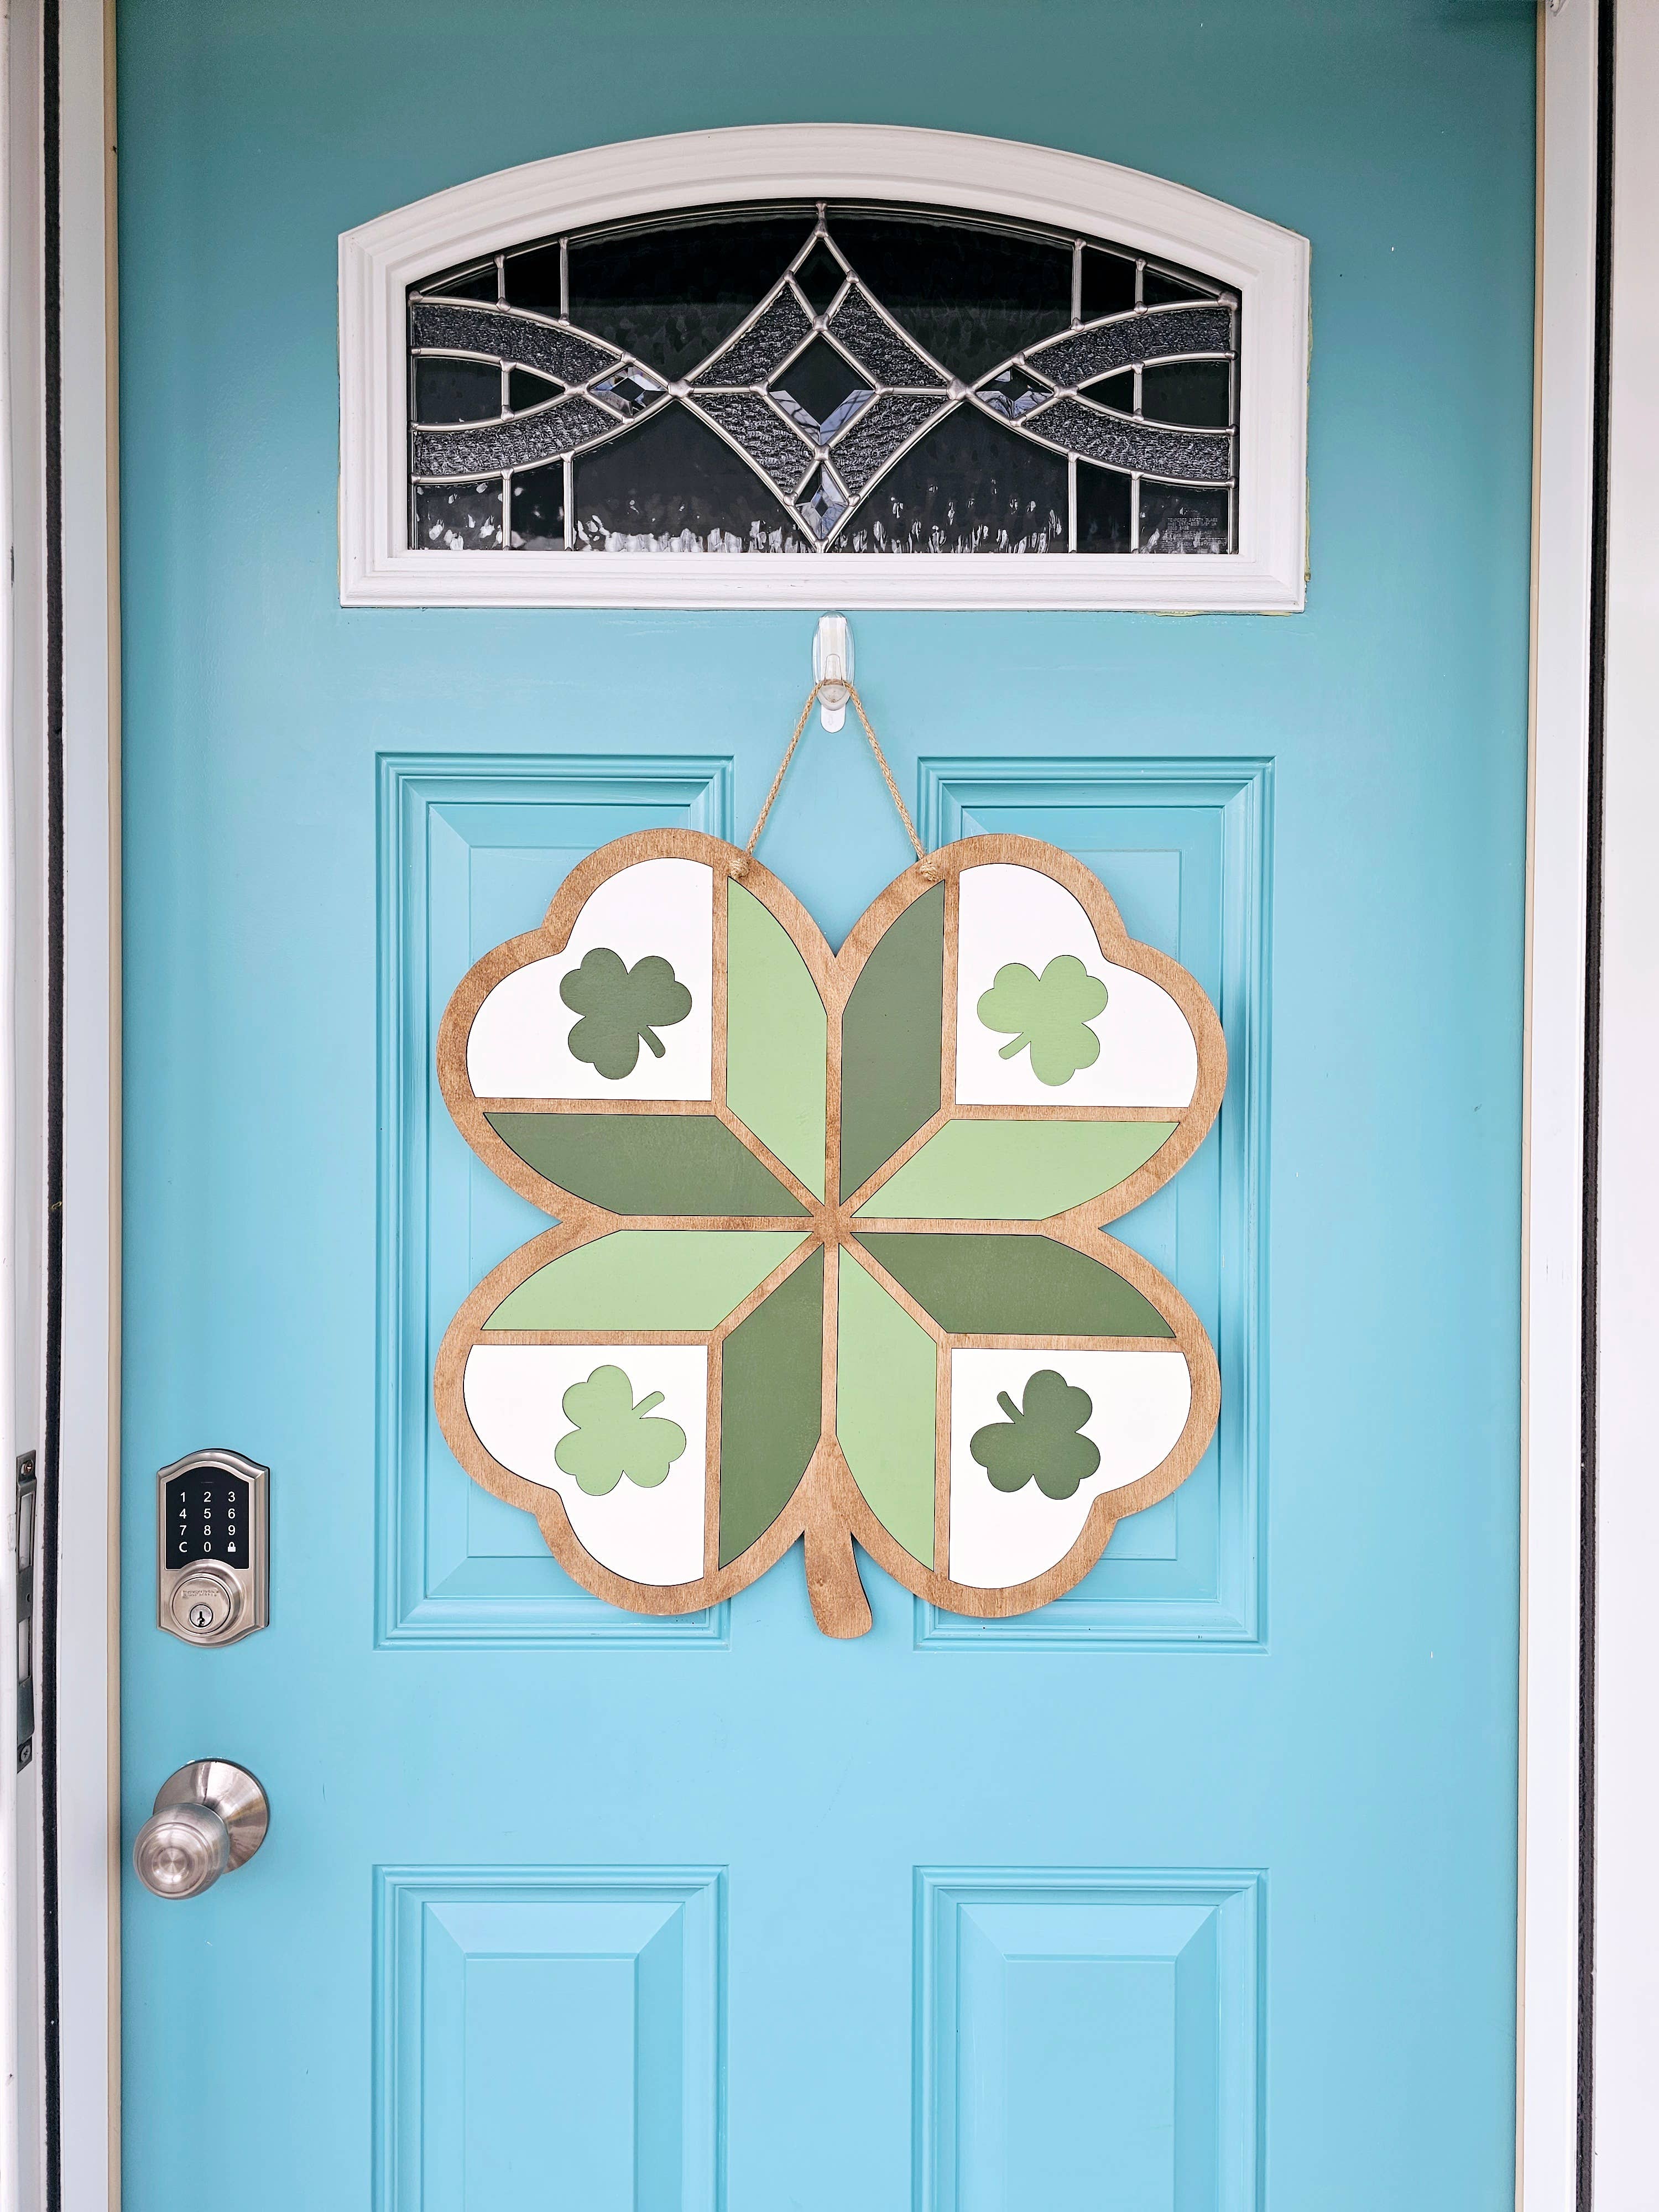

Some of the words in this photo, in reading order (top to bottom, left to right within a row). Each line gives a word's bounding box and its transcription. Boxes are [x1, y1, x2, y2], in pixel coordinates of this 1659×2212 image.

[180, 1491, 186, 1502] 1
[204, 1491, 211, 1502] 2
[228, 1491, 236, 1502] 3
[179, 1508, 187, 1519] 4
[204, 1508, 211, 1519] 5
[228, 1508, 236, 1519] 6
[179, 1525, 187, 1535] 7
[204, 1525, 211, 1535] 8
[228, 1525, 236, 1535] 9
[179, 1541, 187, 1552] C
[204, 1541, 211, 1552] 0
